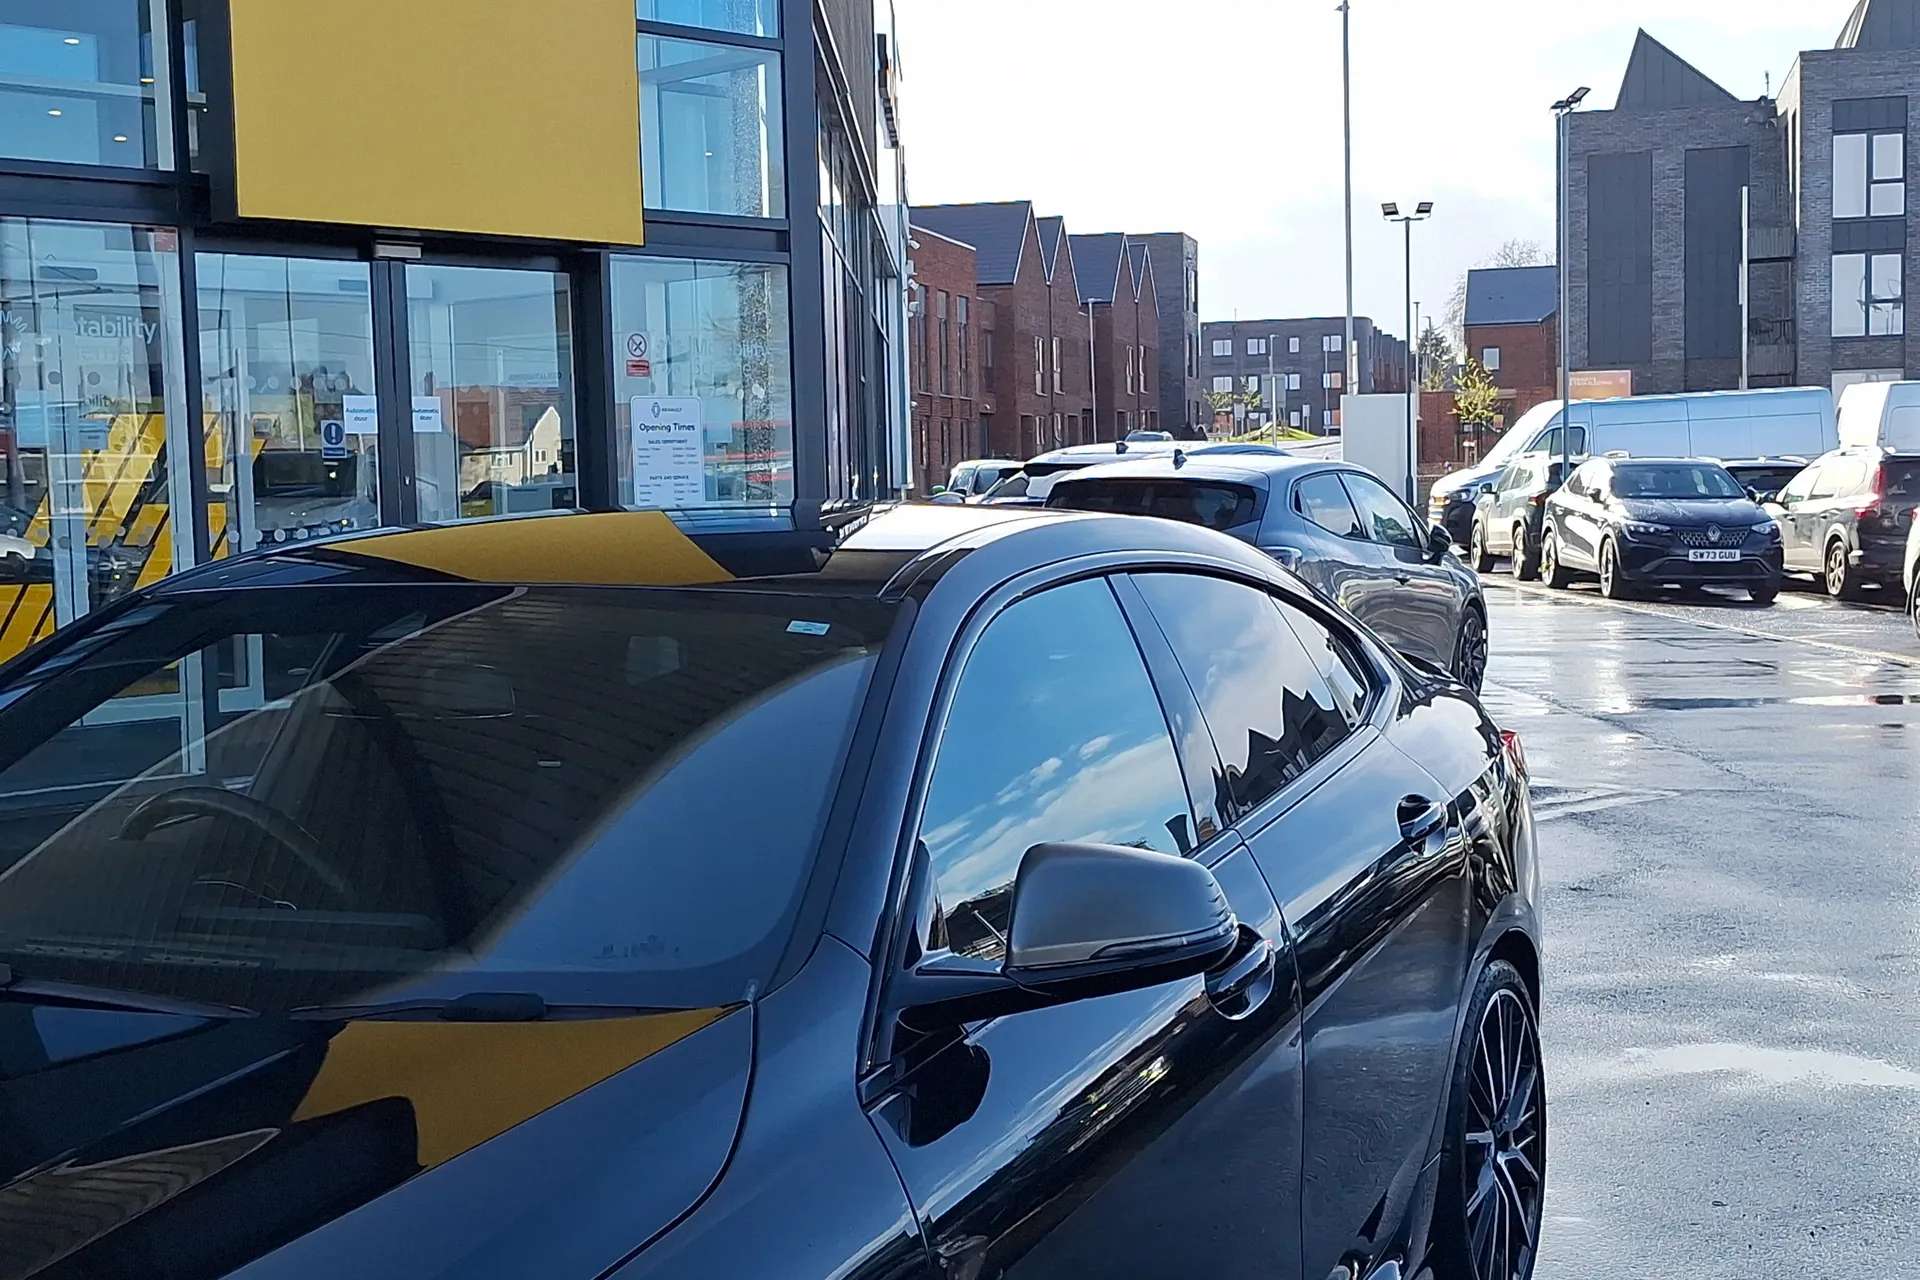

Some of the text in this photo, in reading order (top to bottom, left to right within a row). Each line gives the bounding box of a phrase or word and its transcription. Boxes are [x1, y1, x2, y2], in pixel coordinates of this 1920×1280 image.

[639, 422, 695, 433] Opening Times
[1718, 551, 1736, 560] GUU
